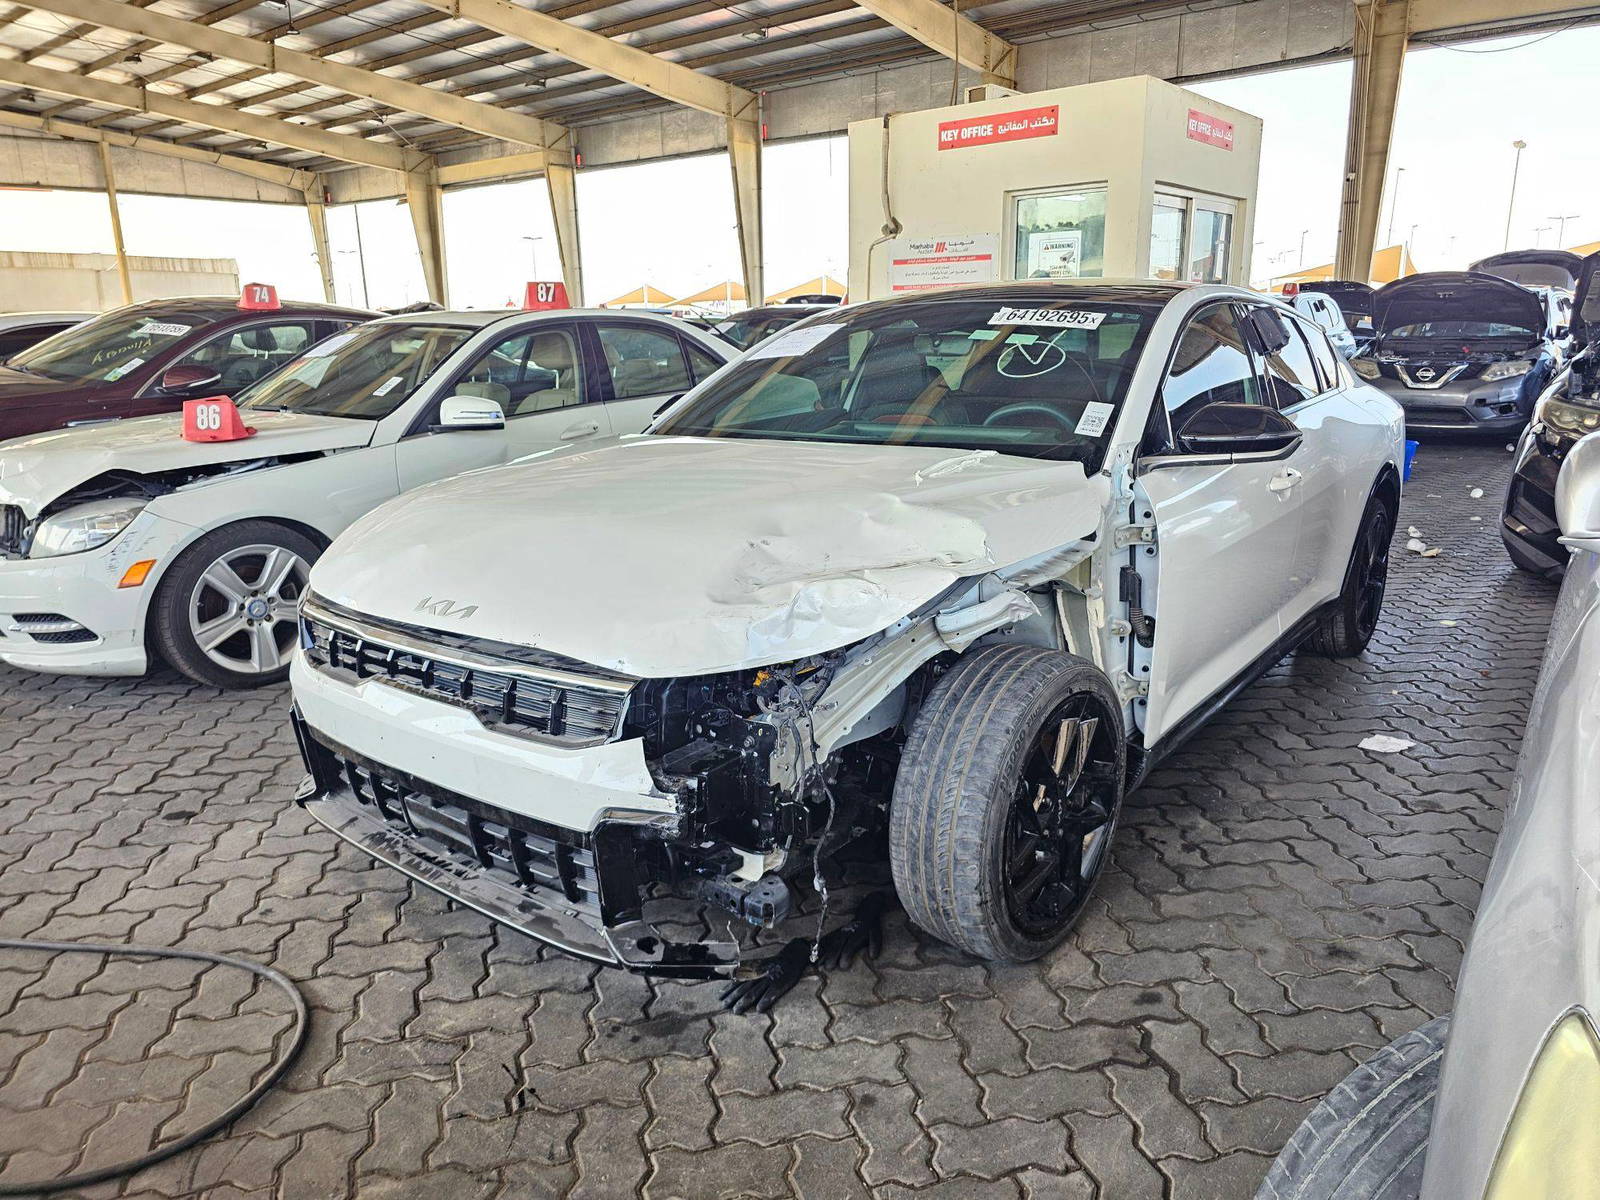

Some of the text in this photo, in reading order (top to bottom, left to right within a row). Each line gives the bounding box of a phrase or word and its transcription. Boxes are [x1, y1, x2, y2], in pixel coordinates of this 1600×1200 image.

[941, 124, 994, 142] KEY OFFICE
[998, 116, 1055, 134] مكتب المفاتيح
[1050, 242, 1074, 250] WARNING
[253, 287, 270, 303] 74
[537, 283, 555, 302] 87
[196, 404, 221, 430] 86
[413, 595, 479, 620] KIA
